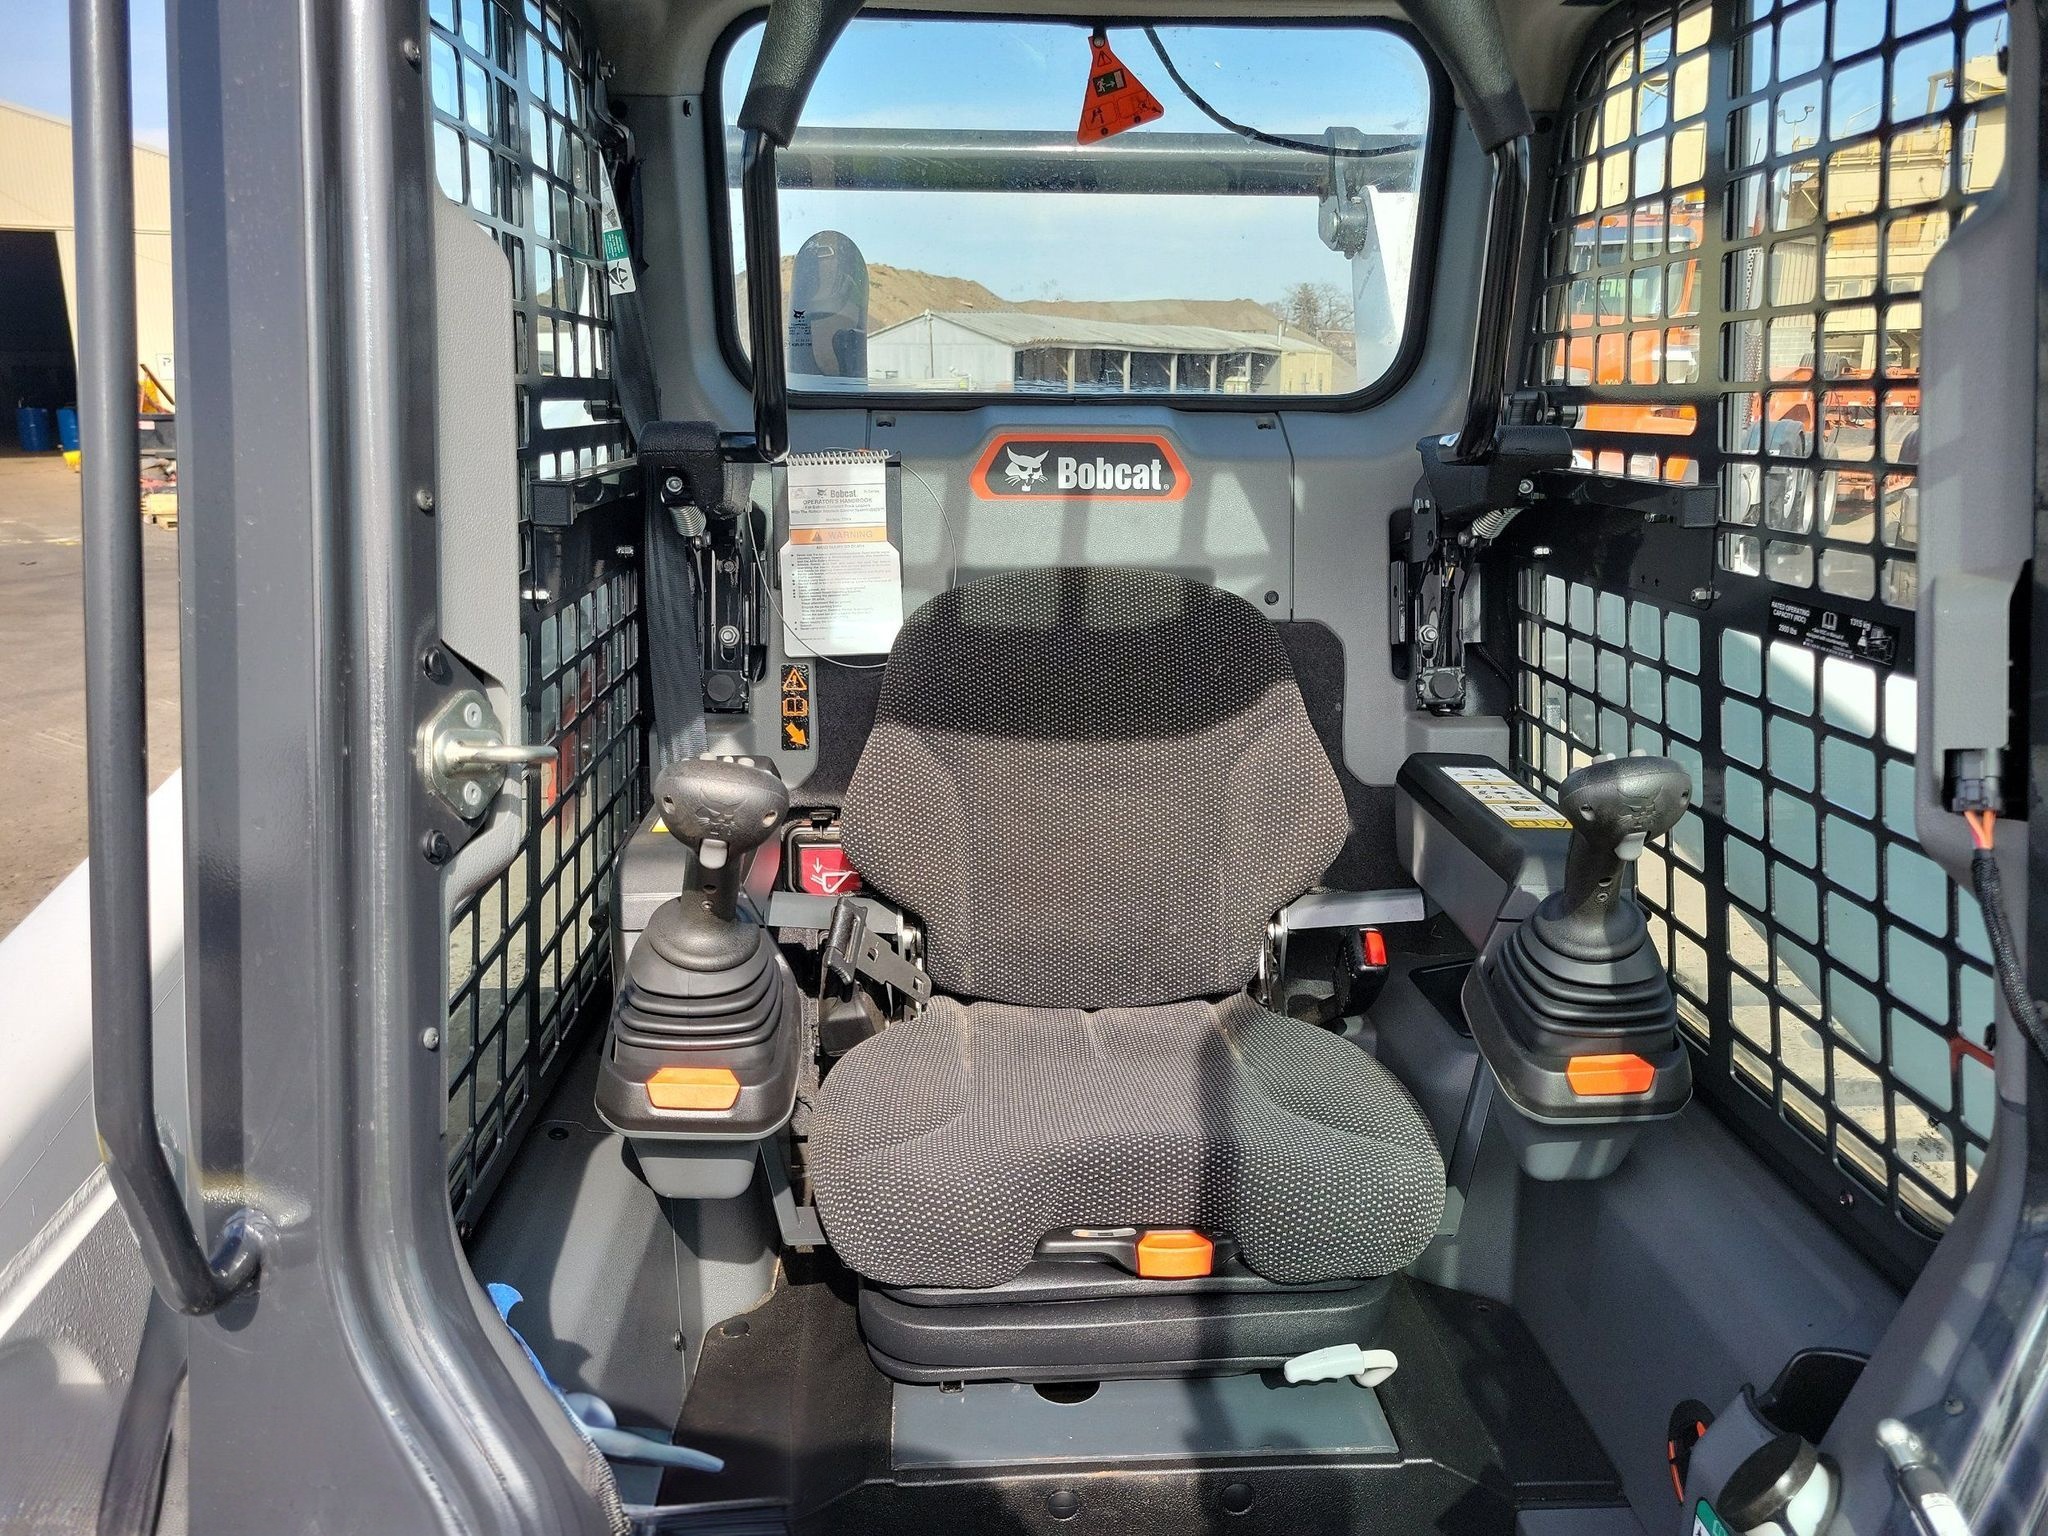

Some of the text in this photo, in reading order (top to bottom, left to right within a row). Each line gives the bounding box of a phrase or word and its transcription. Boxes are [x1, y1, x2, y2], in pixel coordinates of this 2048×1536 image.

[1057, 457, 1163, 491] Bobcat
[830, 489, 857, 498] Bobcat
[829, 530, 873, 539] WARNING
[1772, 602, 1810, 616] RATED OPERATING
[1773, 609, 1793, 620] CAPACITY
